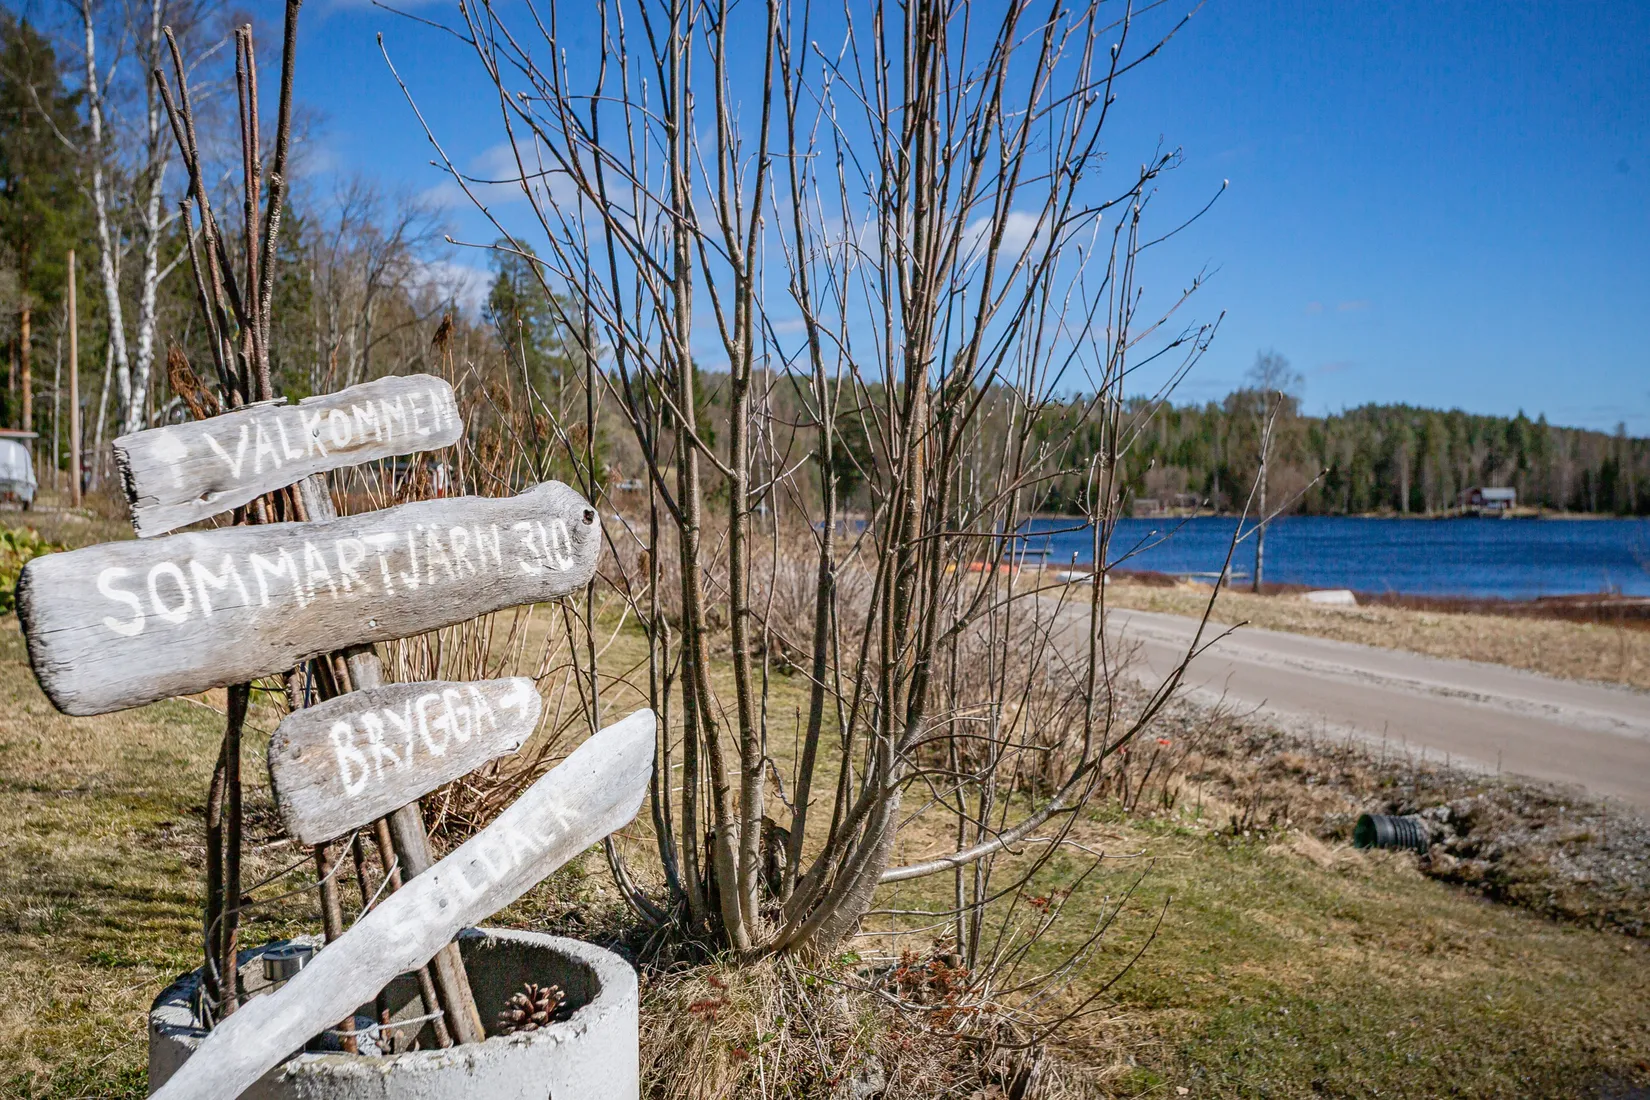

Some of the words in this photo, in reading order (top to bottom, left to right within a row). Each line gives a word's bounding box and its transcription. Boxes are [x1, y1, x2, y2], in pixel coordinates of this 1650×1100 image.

[97, 523, 503, 637] SOMMARTJÄRN
[513, 518, 575, 577] 310
[328, 685, 497, 797] BRYGGA
